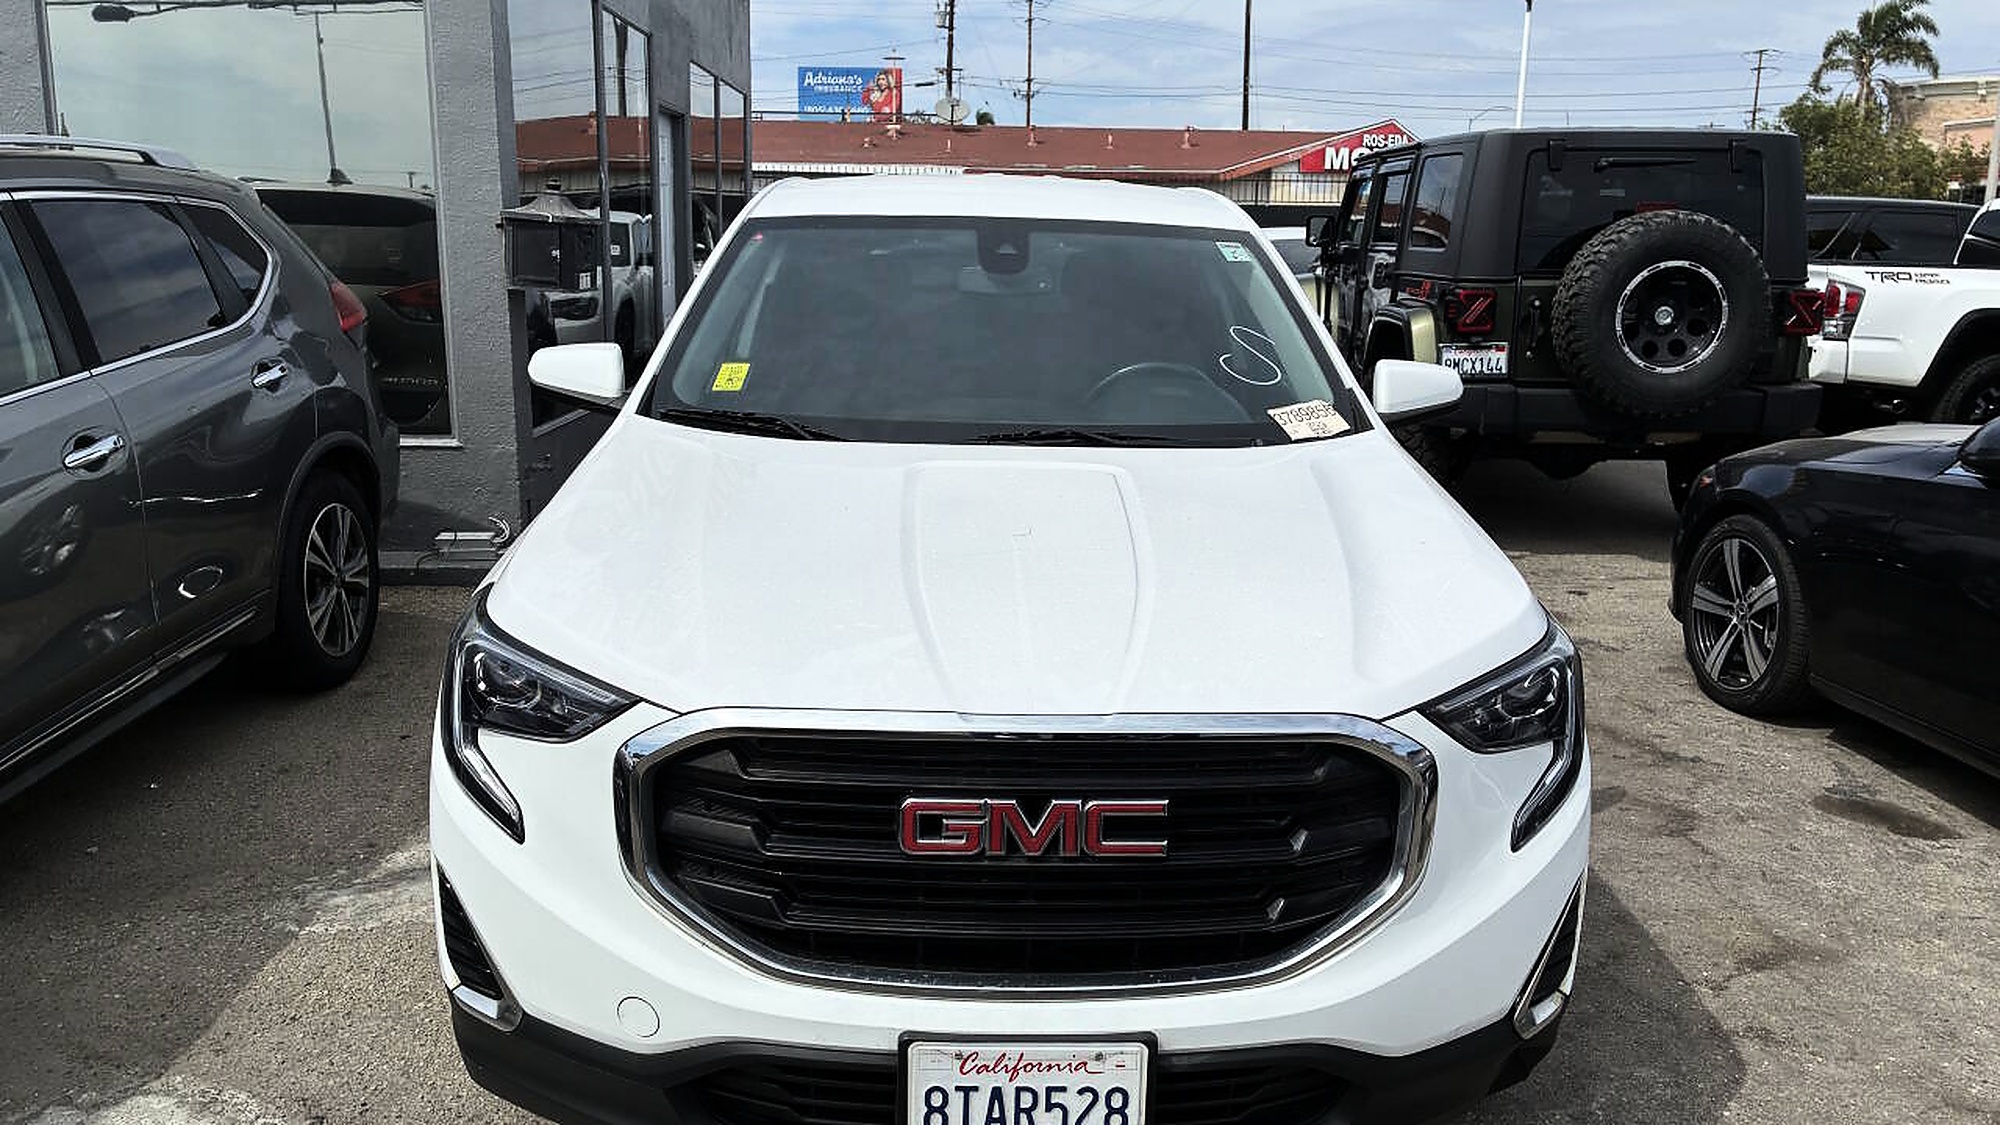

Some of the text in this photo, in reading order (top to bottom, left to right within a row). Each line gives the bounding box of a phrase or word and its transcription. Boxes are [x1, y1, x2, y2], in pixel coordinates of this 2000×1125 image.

[804, 72, 863, 86] Adriana's
[1324, 147, 1378, 170] MO
[900, 798, 1169, 856] GMC
[959, 1050, 1104, 1083] California
[923, 1085, 1130, 1125] 8TAR528
